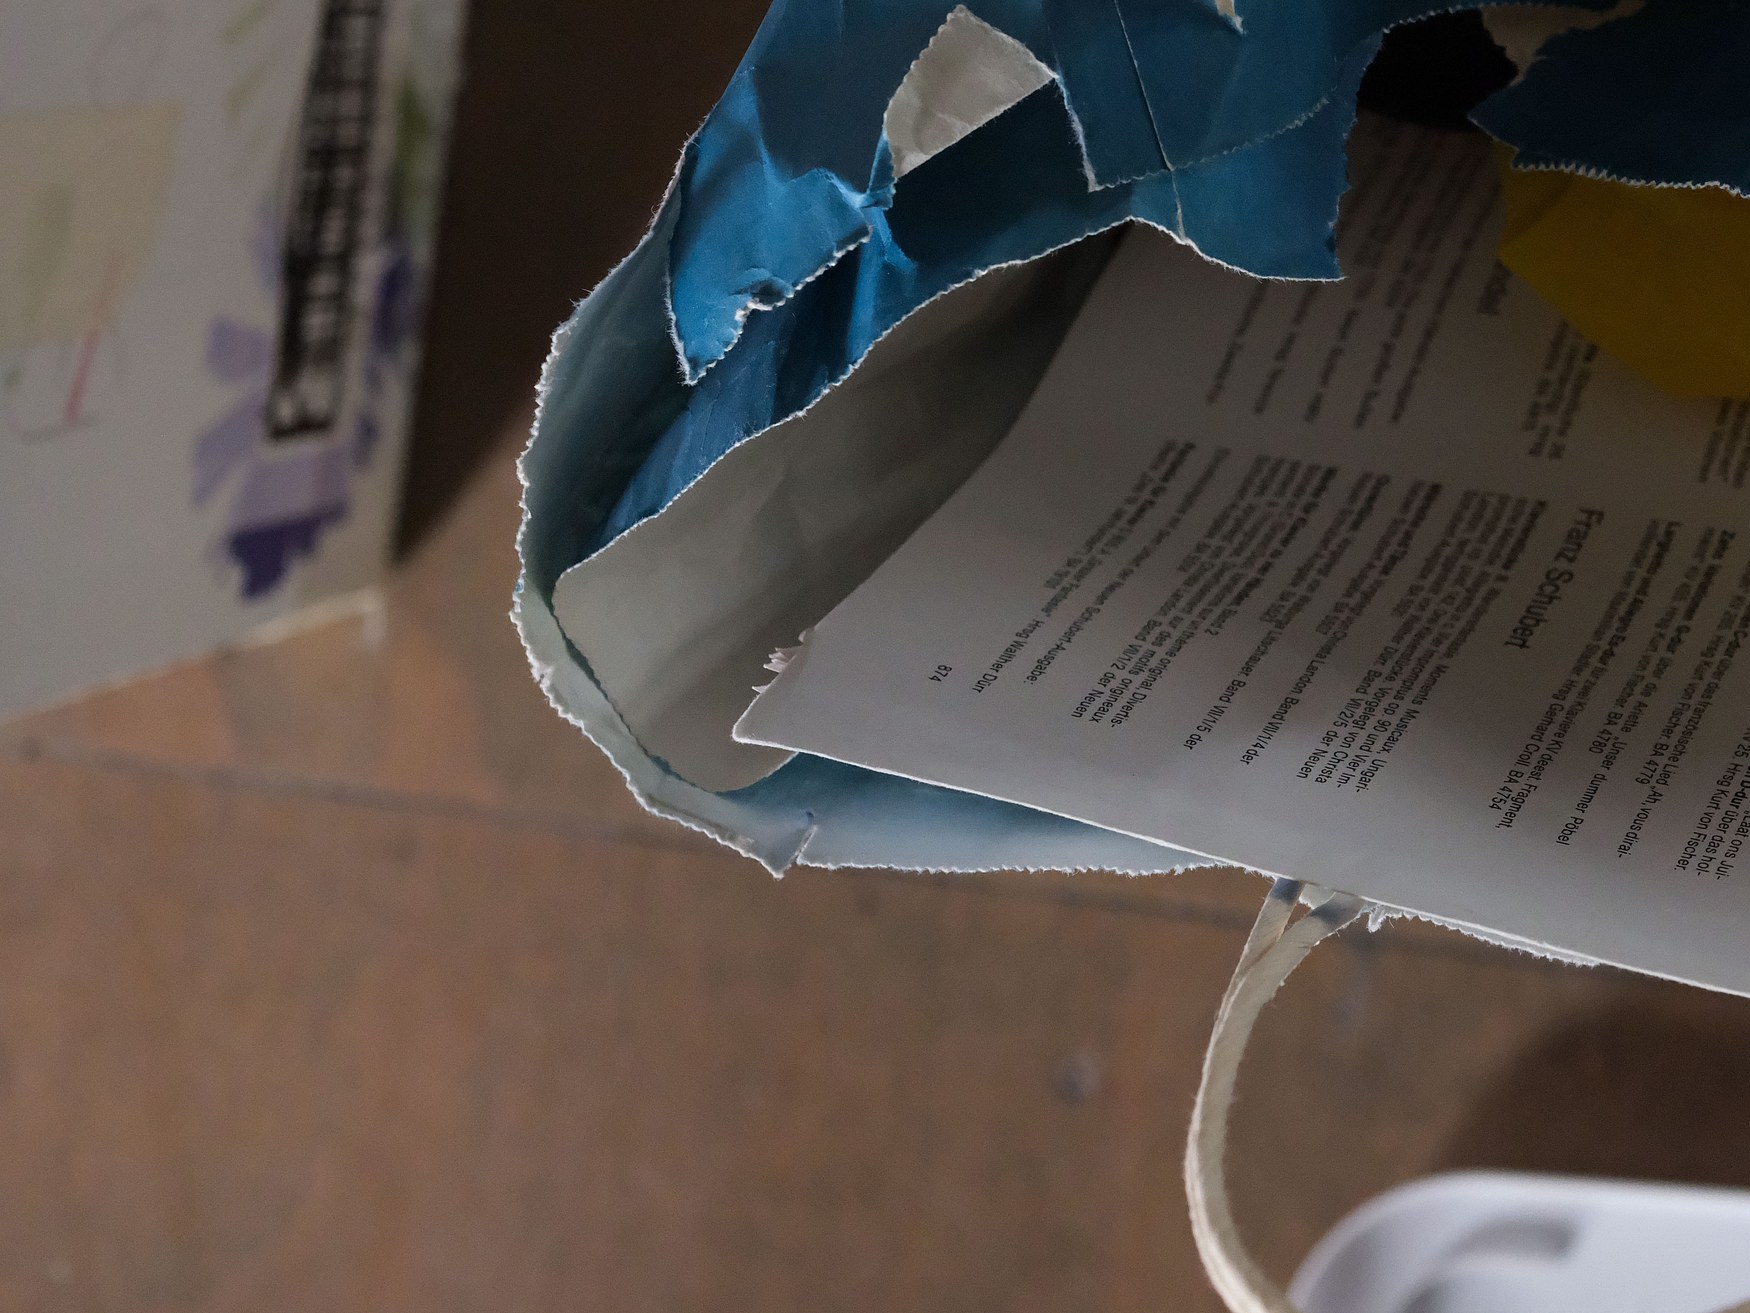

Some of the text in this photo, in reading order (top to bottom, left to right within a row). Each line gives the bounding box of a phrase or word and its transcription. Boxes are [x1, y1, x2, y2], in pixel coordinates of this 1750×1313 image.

[1553, 504, 1607, 566] Franz
[1504, 563, 1572, 652] Schubert
[971, 638, 1026, 694] Walther Dürr
[1084, 648, 1160, 724] motifs origineaux
[1217, 678, 1246, 704] Band
[1069, 688, 1105, 719] Neuen
[1106, 691, 1147, 729] Divertis-
[1271, 695, 1299, 721] Band
[1314, 683, 1393, 785] Vorgelegt Christa
[1358, 732, 1382, 753] und
[1295, 747, 1328, 780] Neuen
[1350, 706, 1419, 795] Musicaux, Ungari-
[1634, 758, 1659, 786] 4779
[1654, 762, 1678, 787] Lied
[1488, 784, 1514, 811] 4754
[1492, 780, 1537, 831] Fragment,
[1573, 772, 1608, 814] dummer
[1707, 787, 1729, 811] Kurt
[1554, 815, 1583, 846] Pöbel
[1629, 806, 1651, 831] vous
[1715, 808, 1739, 835] über
[1613, 831, 1640, 859] dirai-
[1673, 830, 1706, 874] Fischer.
[1704, 833, 1726, 856] das
[1692, 854, 1716, 878] hol-
[1712, 859, 1734, 882] Jui-
